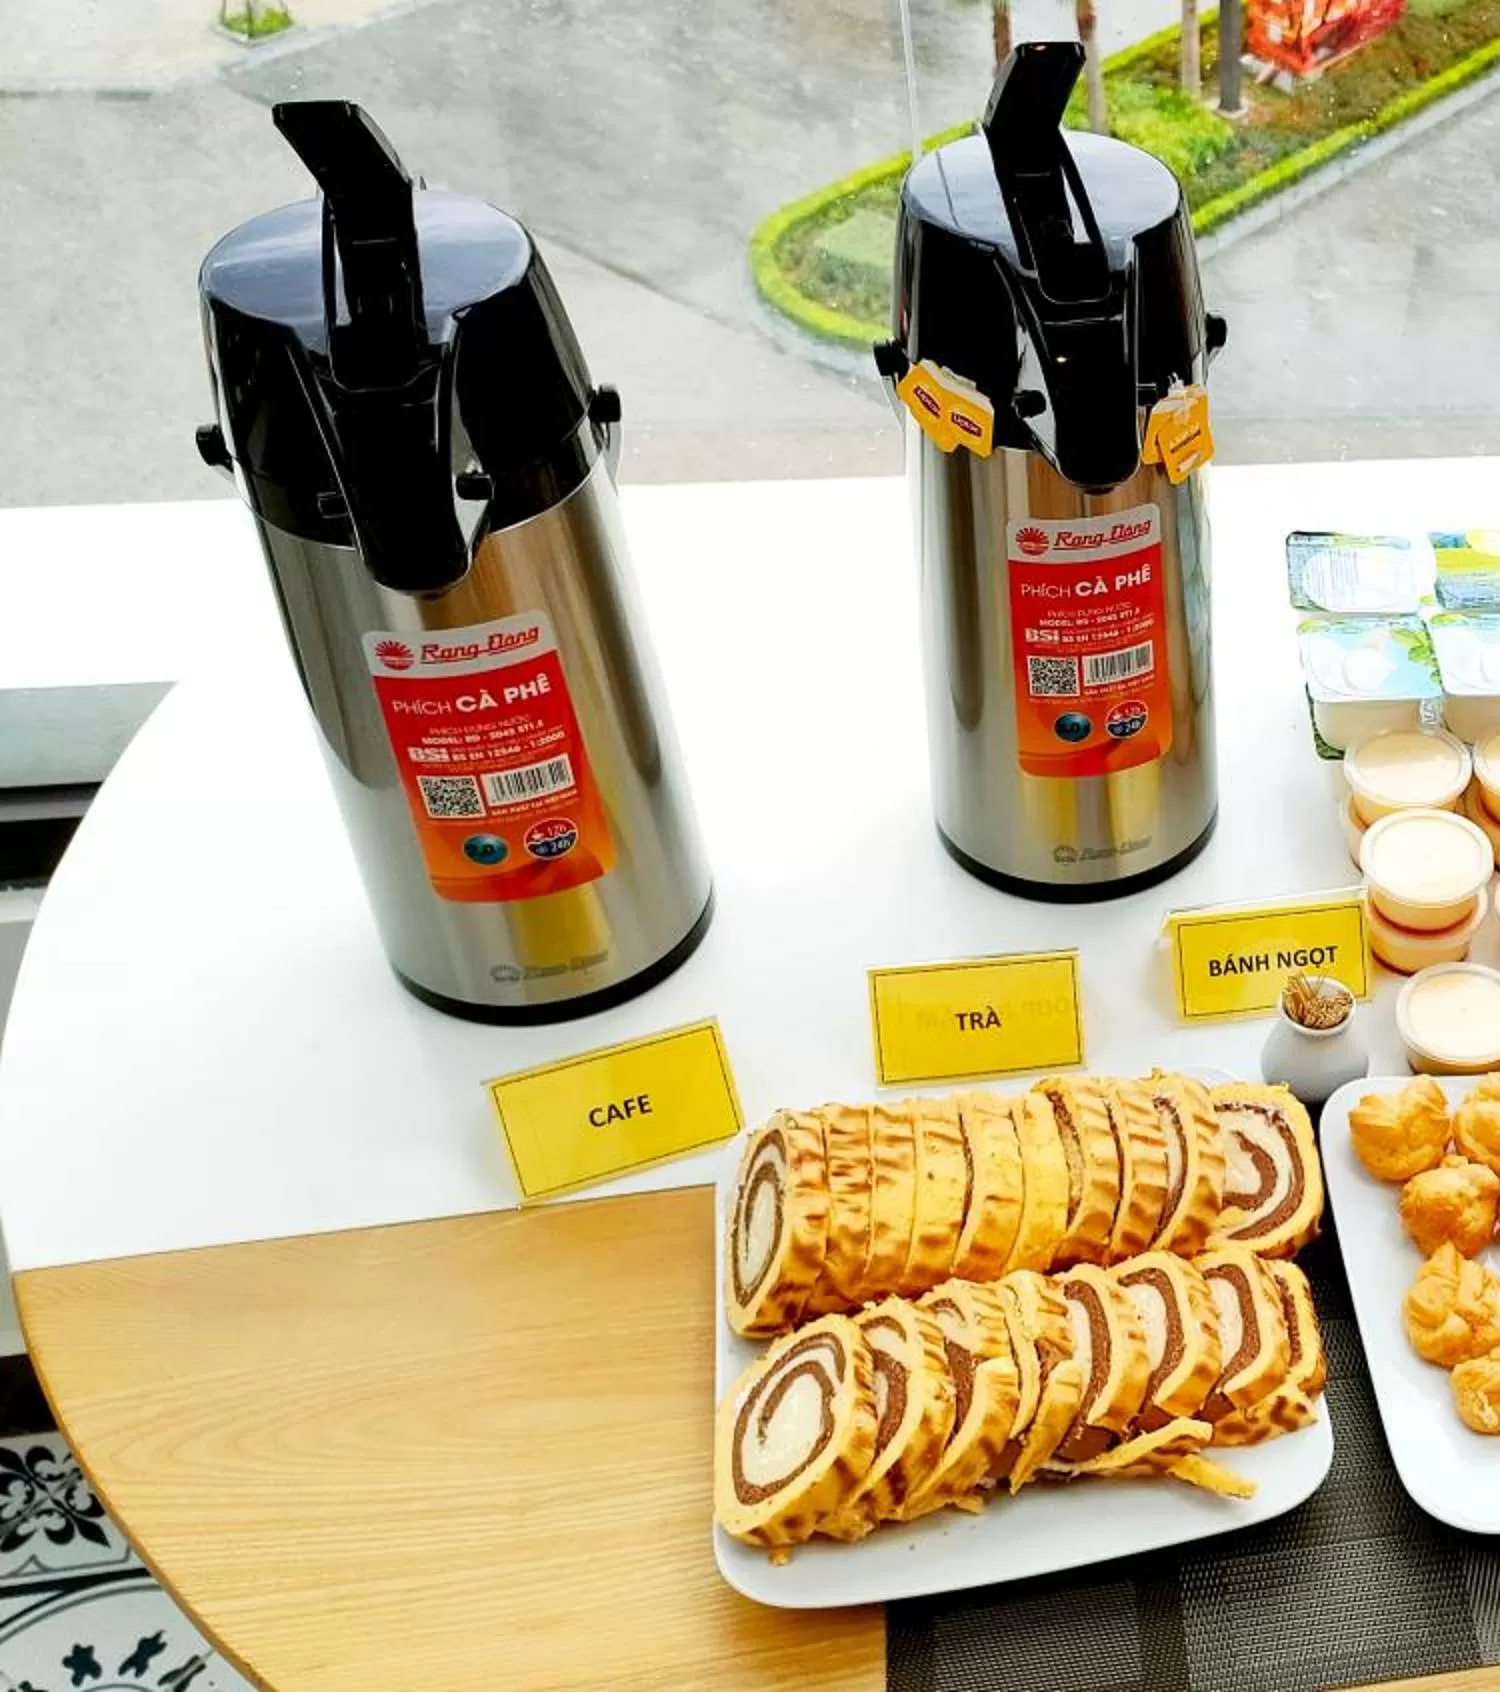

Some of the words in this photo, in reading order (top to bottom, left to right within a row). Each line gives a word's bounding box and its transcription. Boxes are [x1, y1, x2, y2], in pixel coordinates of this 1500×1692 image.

[1020, 582, 1071, 599] PHÍCH
[1074, 574, 1109, 597] CÀ
[1114, 563, 1152, 592] PHÊ
[391, 697, 451, 716] PHÍCH
[455, 689, 499, 713] CÀ
[503, 672, 552, 705] PHÊ
[1208, 953, 1269, 977] BÁNH
[1277, 945, 1338, 969] NGỌT
[954, 1004, 1002, 1032] TRÀ
[589, 1094, 653, 1128] CAFE
